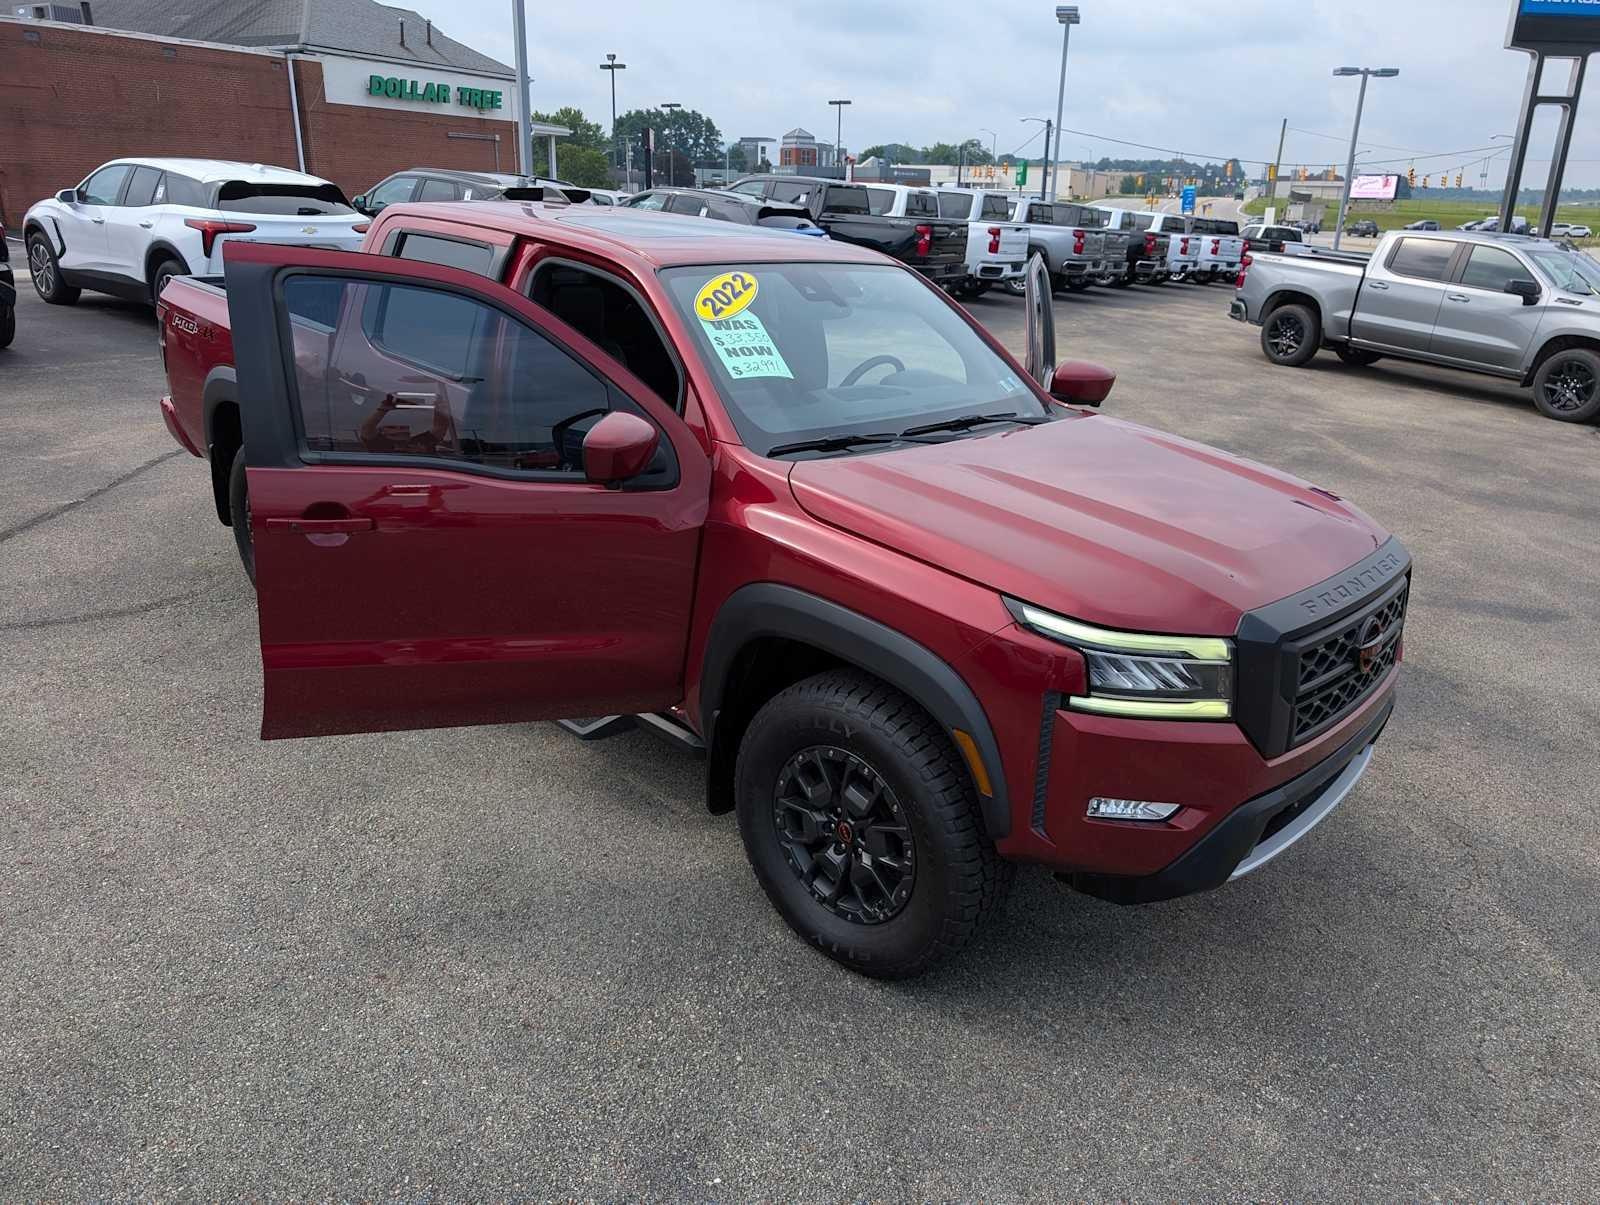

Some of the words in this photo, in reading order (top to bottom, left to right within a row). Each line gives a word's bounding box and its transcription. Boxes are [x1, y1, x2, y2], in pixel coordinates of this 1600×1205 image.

[368, 75, 450, 104] DOLLAR
[457, 87, 502, 110] TREE
[702, 273, 753, 317] 2022
[710, 319, 759, 331] WAS
[724, 345, 773, 358] NOW
[1300, 553, 1401, 614] FRONTIER
